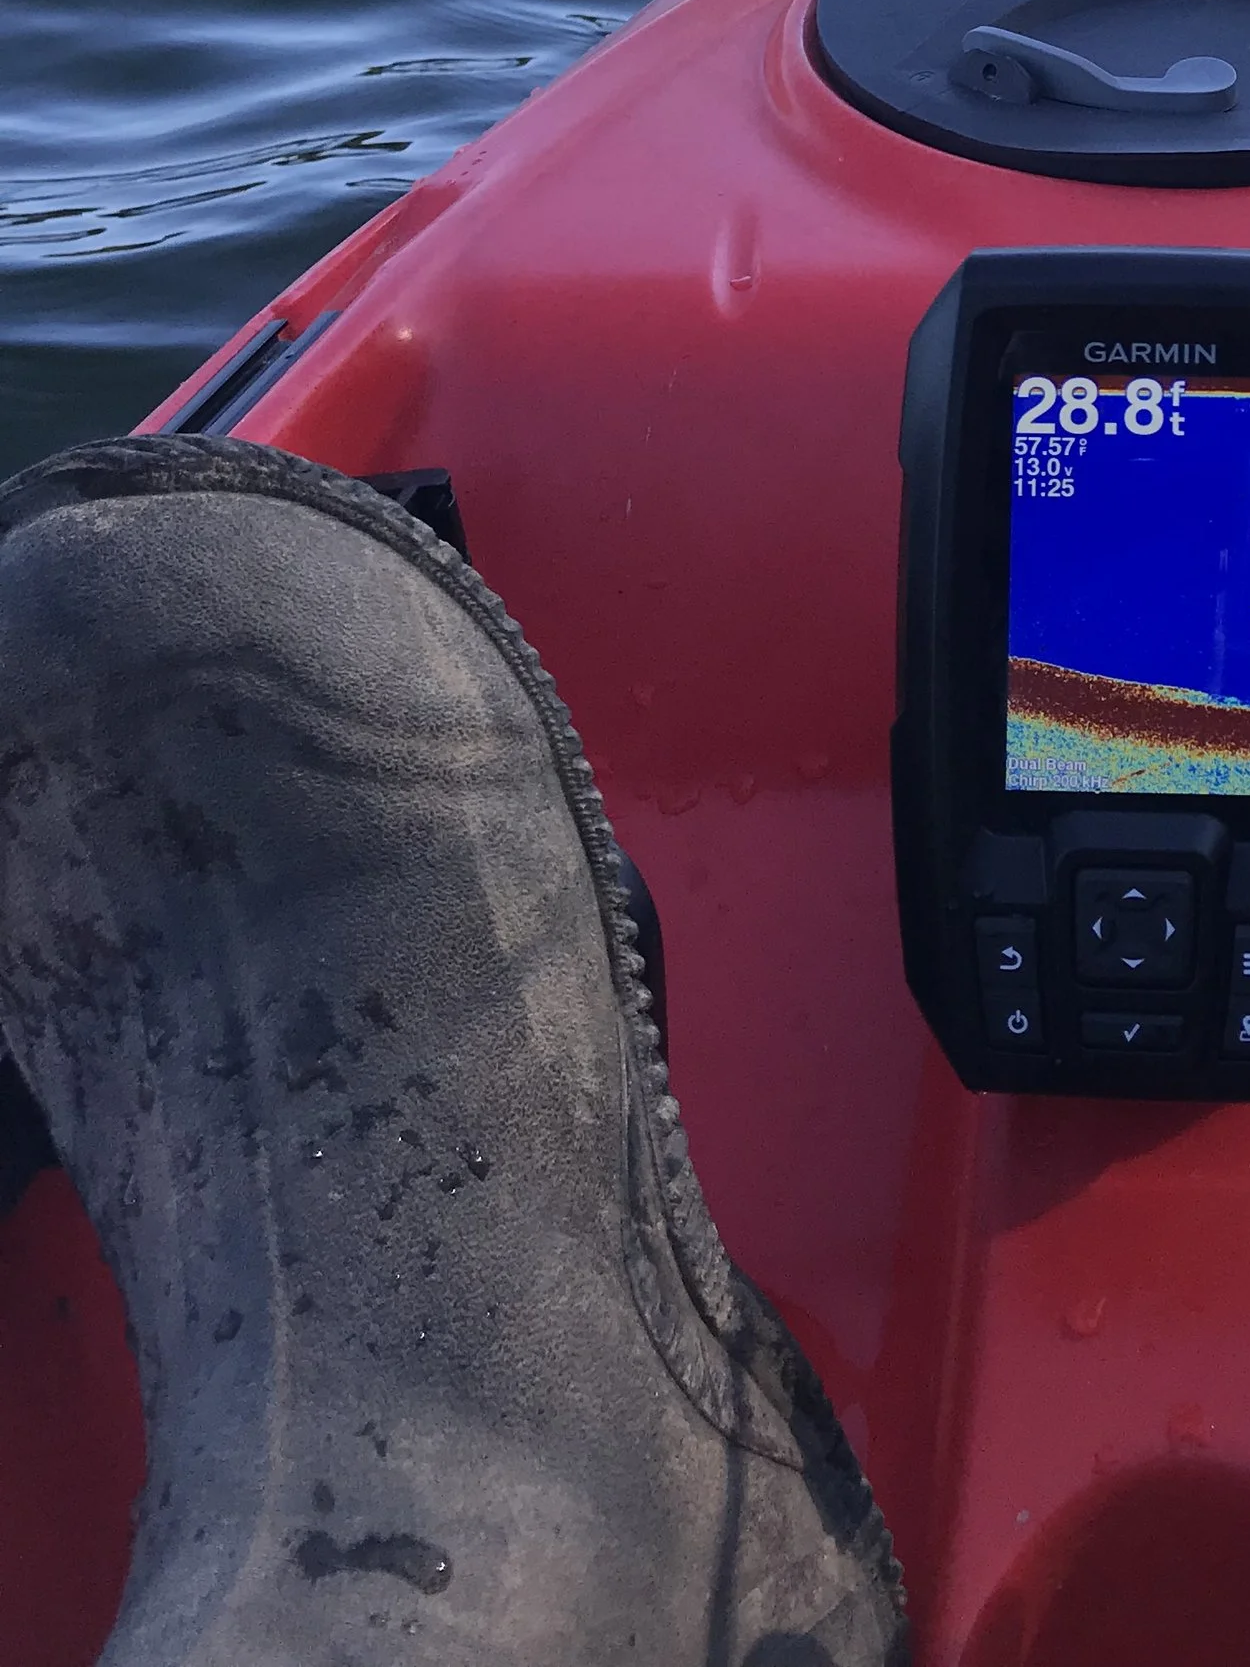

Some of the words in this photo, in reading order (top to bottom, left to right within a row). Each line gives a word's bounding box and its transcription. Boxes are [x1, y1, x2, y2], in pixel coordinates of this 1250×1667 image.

[1083, 341, 1217, 364] GARMIN
[1016, 377, 1164, 435] 28.8
[1014, 437, 1076, 456] 57.57
[1014, 457, 1061, 476] 13.0
[1014, 478, 1075, 497] 11:25
[1008, 757, 1040, 770] Dual
[1046, 758, 1086, 771] Beam
[1009, 774, 1048, 790] Chirp
[1053, 775, 1078, 787] 200
[1082, 776, 1109, 788] kHz
